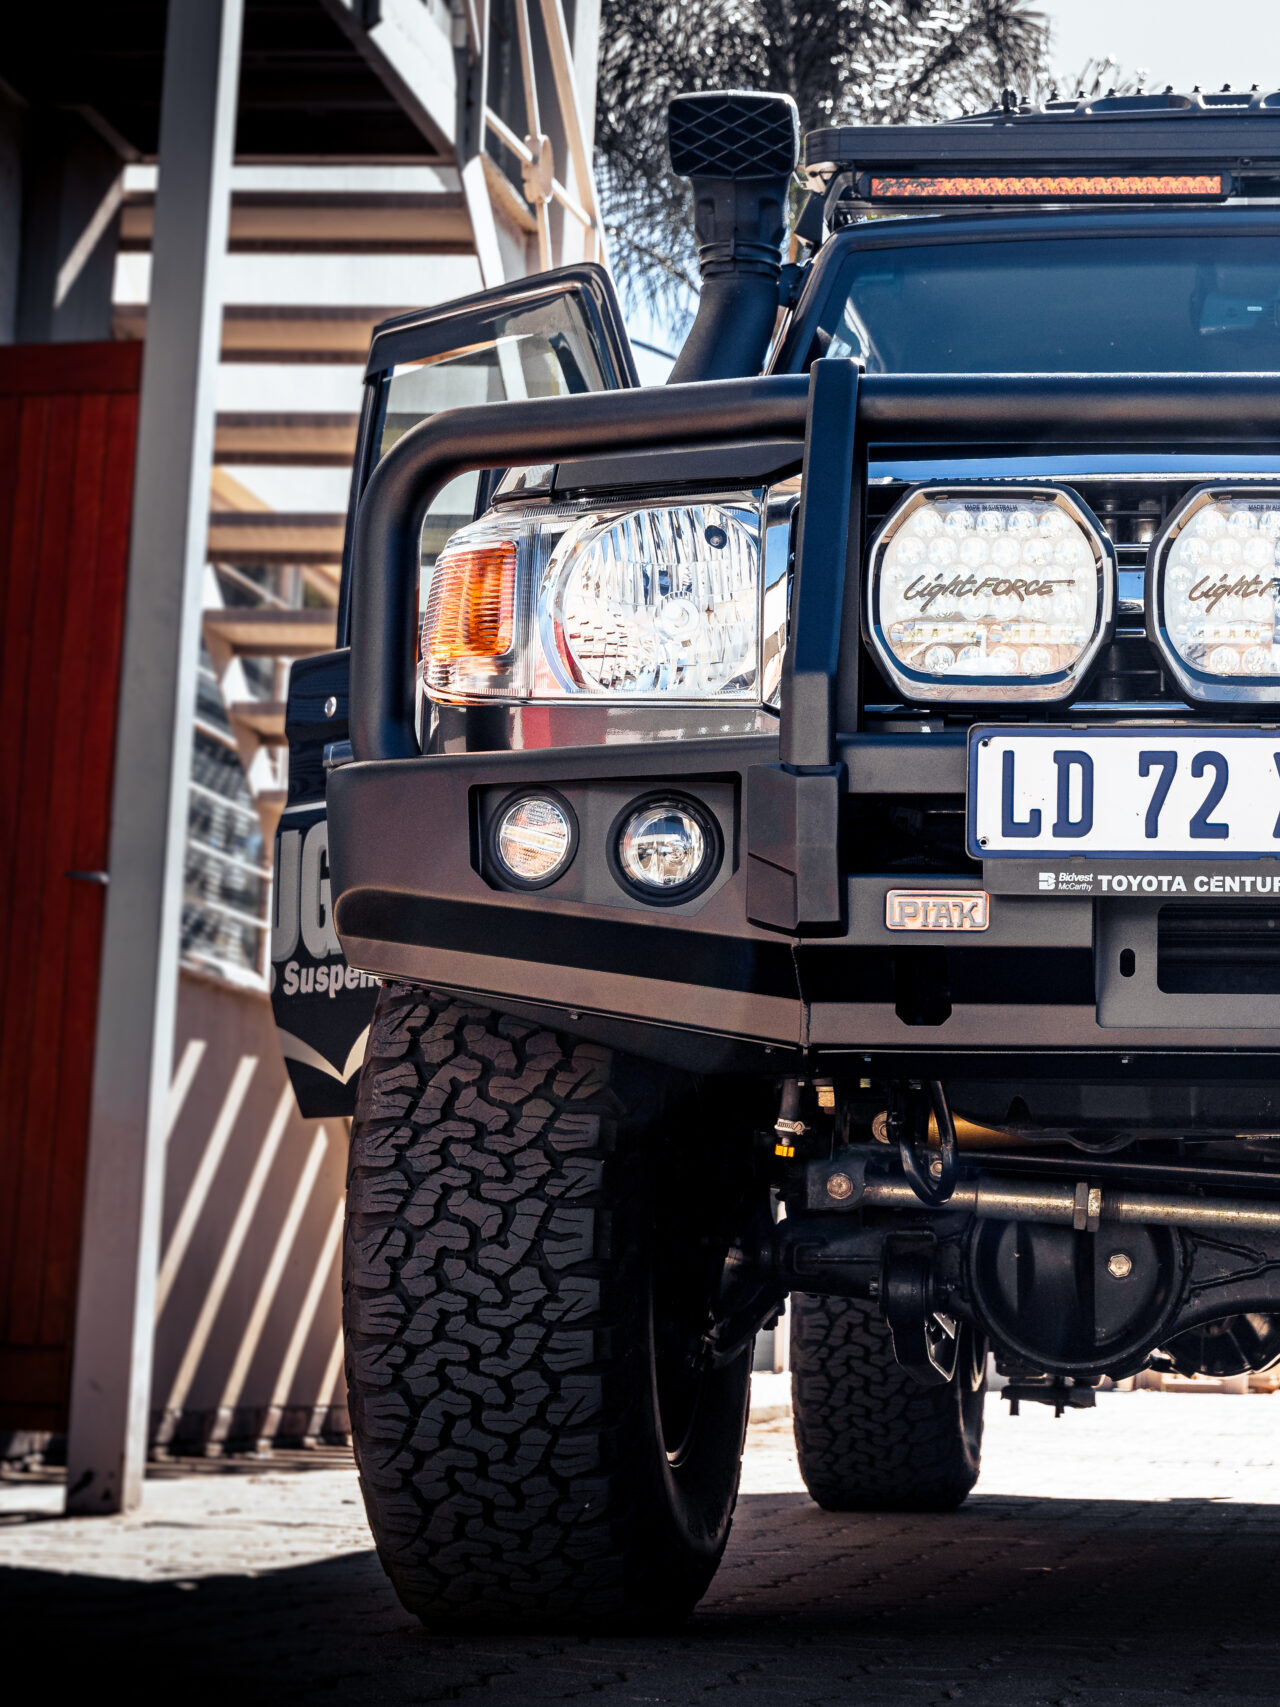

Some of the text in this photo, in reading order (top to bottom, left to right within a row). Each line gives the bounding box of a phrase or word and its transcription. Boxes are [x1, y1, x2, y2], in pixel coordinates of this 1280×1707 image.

[1001, 750, 1094, 838] LD
[1139, 750, 1229, 838] 72
[1058, 872, 1094, 882] Bidvest
[1097, 875, 1188, 892] TOYOTA
[1058, 882, 1093, 892] McCarthy
